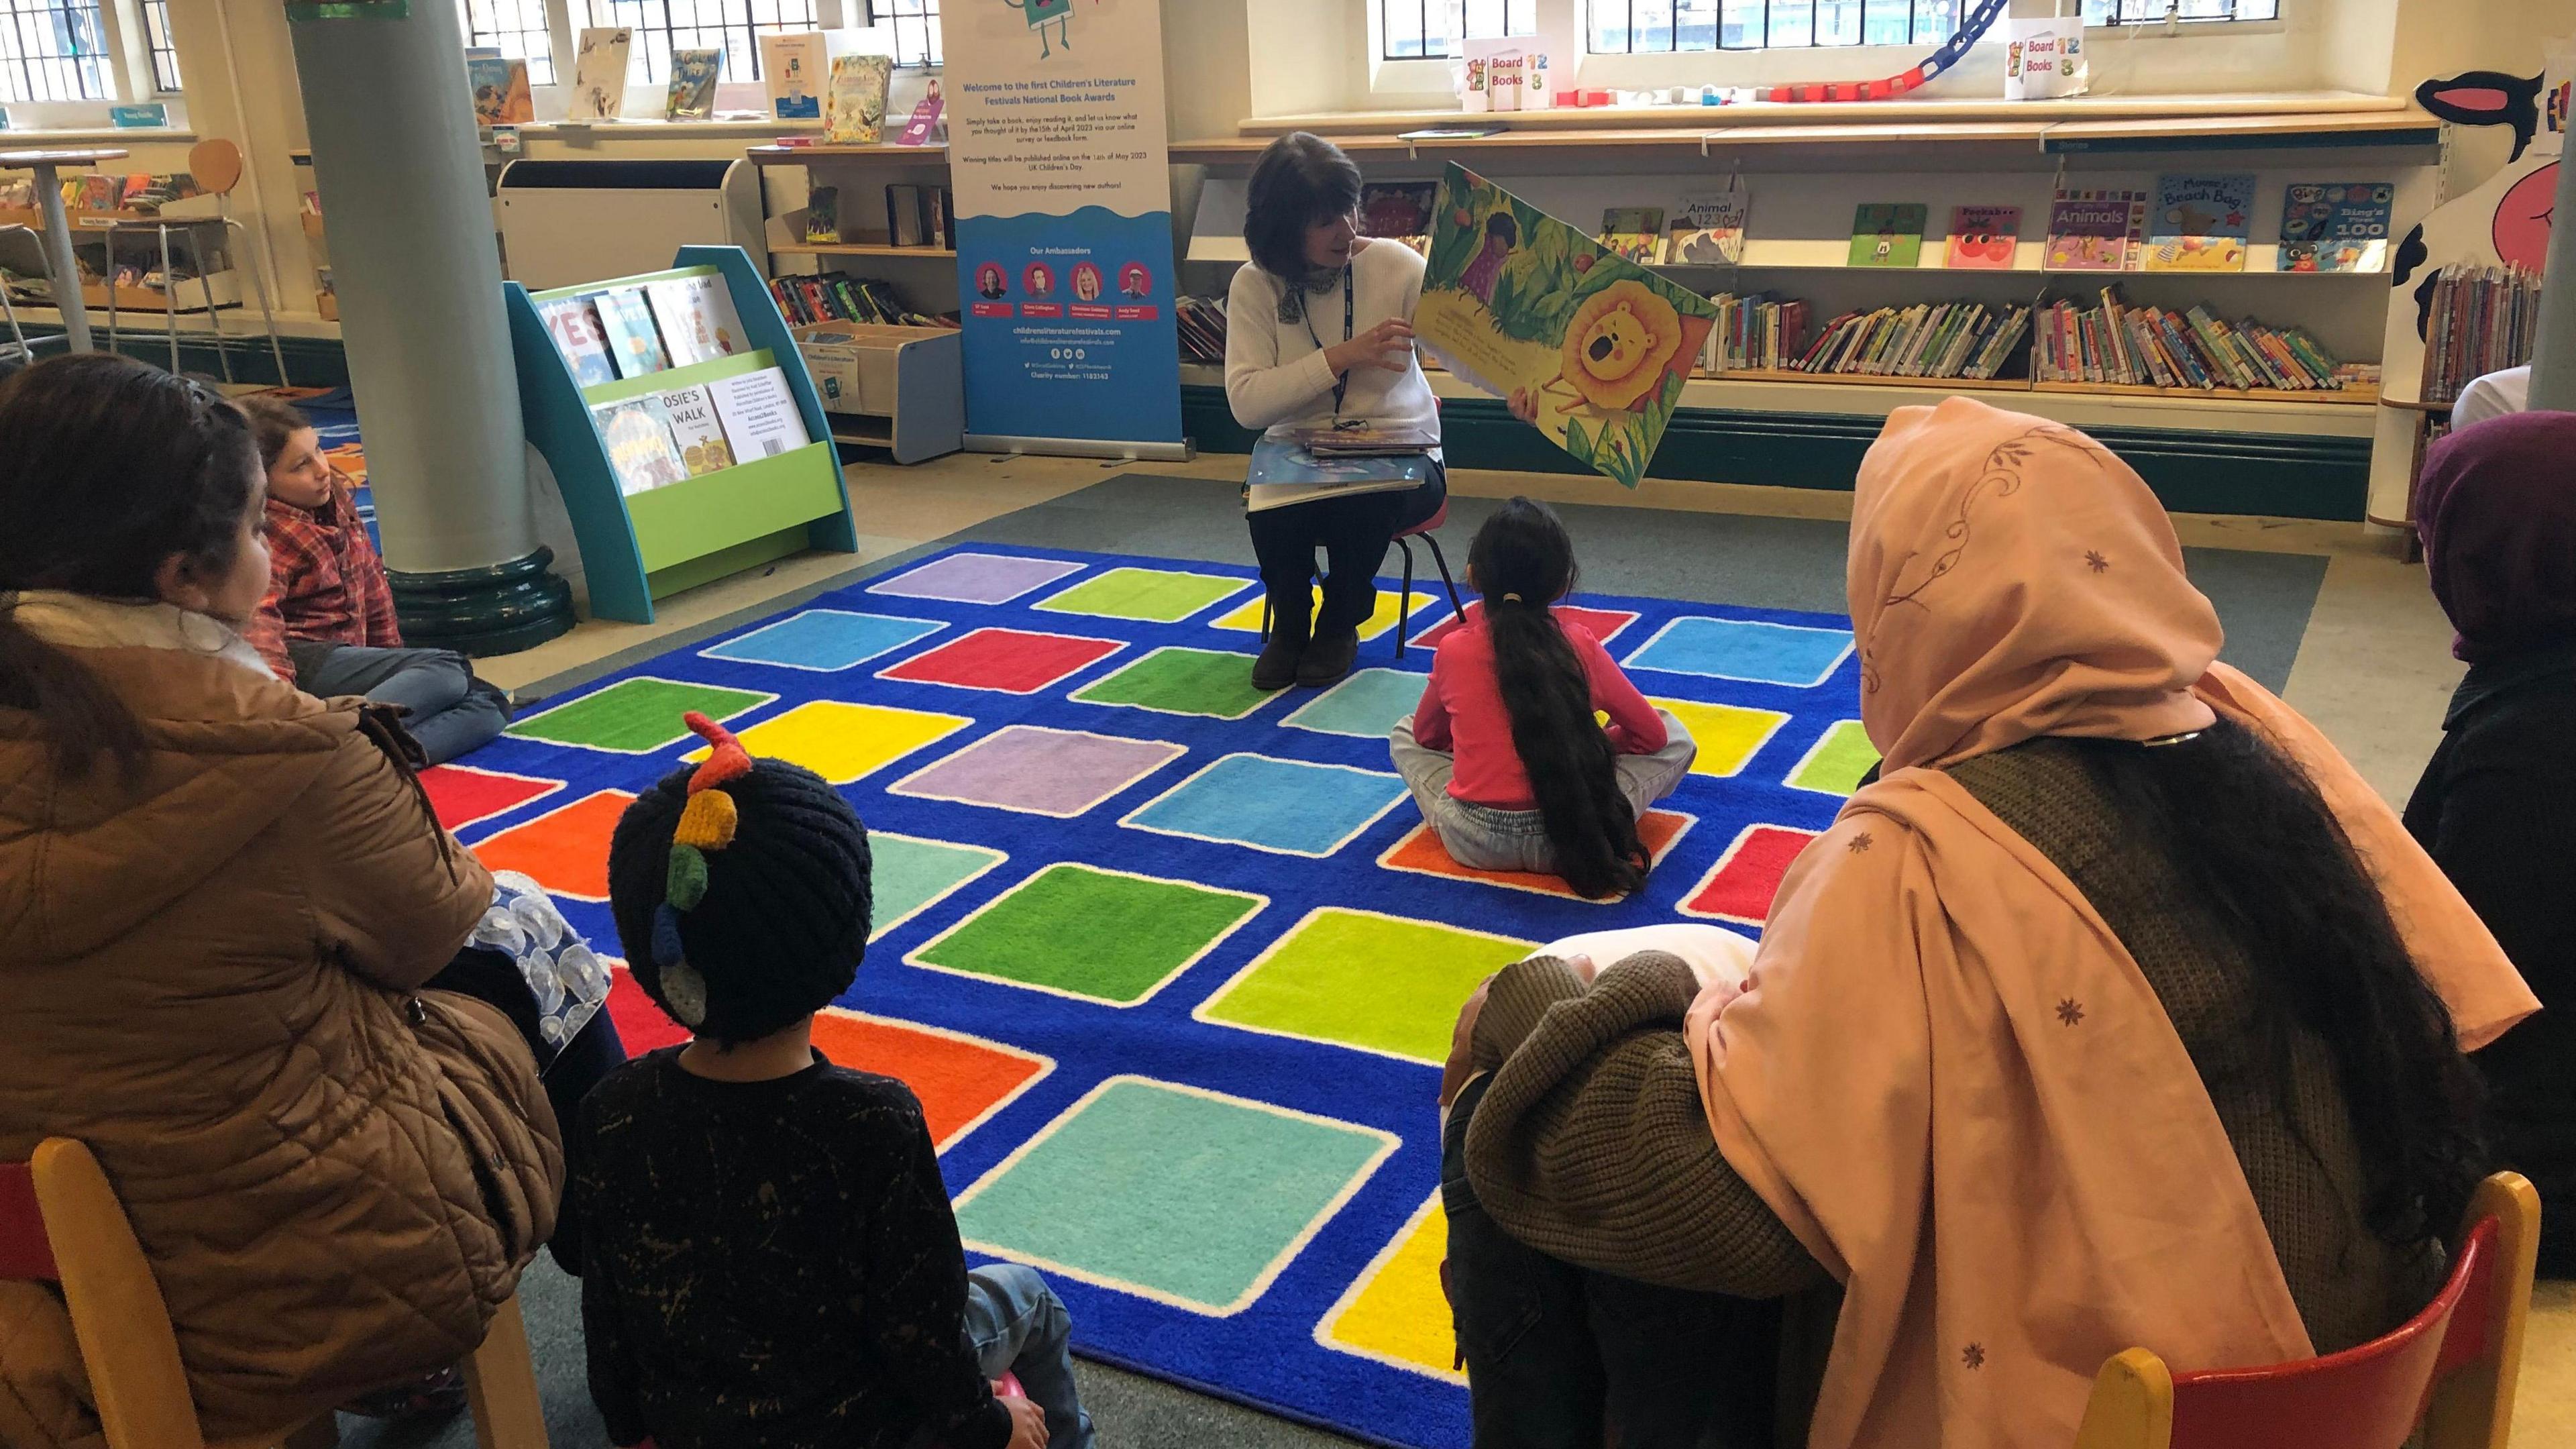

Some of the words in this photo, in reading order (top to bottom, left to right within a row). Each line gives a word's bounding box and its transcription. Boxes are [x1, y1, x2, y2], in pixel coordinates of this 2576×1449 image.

[2029, 40, 2054, 52] Board
[1492, 56, 1523, 68] Board
[2027, 59, 2052, 72] Books
[963, 83, 1002, 92] Welcome
[1015, 82, 1029, 90] the
[1031, 80, 1047, 89] first
[1049, 79, 1092, 89] Children's
[1094, 78, 1136, 87] Literature
[1492, 74, 1523, 86] Books
[985, 97, 1021, 105] Festivals
[1023, 95, 1058, 104] National
[1060, 94, 1082, 103] Book
[1084, 93, 1116, 102] Awards
[966, 117, 985, 126] Simply
[1043, 115, 1066, 123] reading
[1061, 124, 1075, 133] April
[963, 156, 986, 164] Winning
[1024, 154, 1051, 162] published
[1115, 153, 1128, 161] May
[1003, 183, 1018, 192] hope
[1049, 182, 1081, 191] discovering
[2164, 188, 2210, 205] Beach
[2214, 189, 2242, 210] Bag
[1688, 202, 1731, 213] Animal
[2341, 208, 2384, 217] Bing's
[1698, 213, 1721, 225] 123
[2056, 209, 2124, 223] Animals
[2337, 223, 2384, 235] 100
[1030, 246, 1043, 254] Our
[1045, 246, 1091, 254] Ambassadors
[1031, 372, 1053, 380] Charity
[663, 390, 700, 408] OSIE'S
[672, 407, 706, 425] WALK
